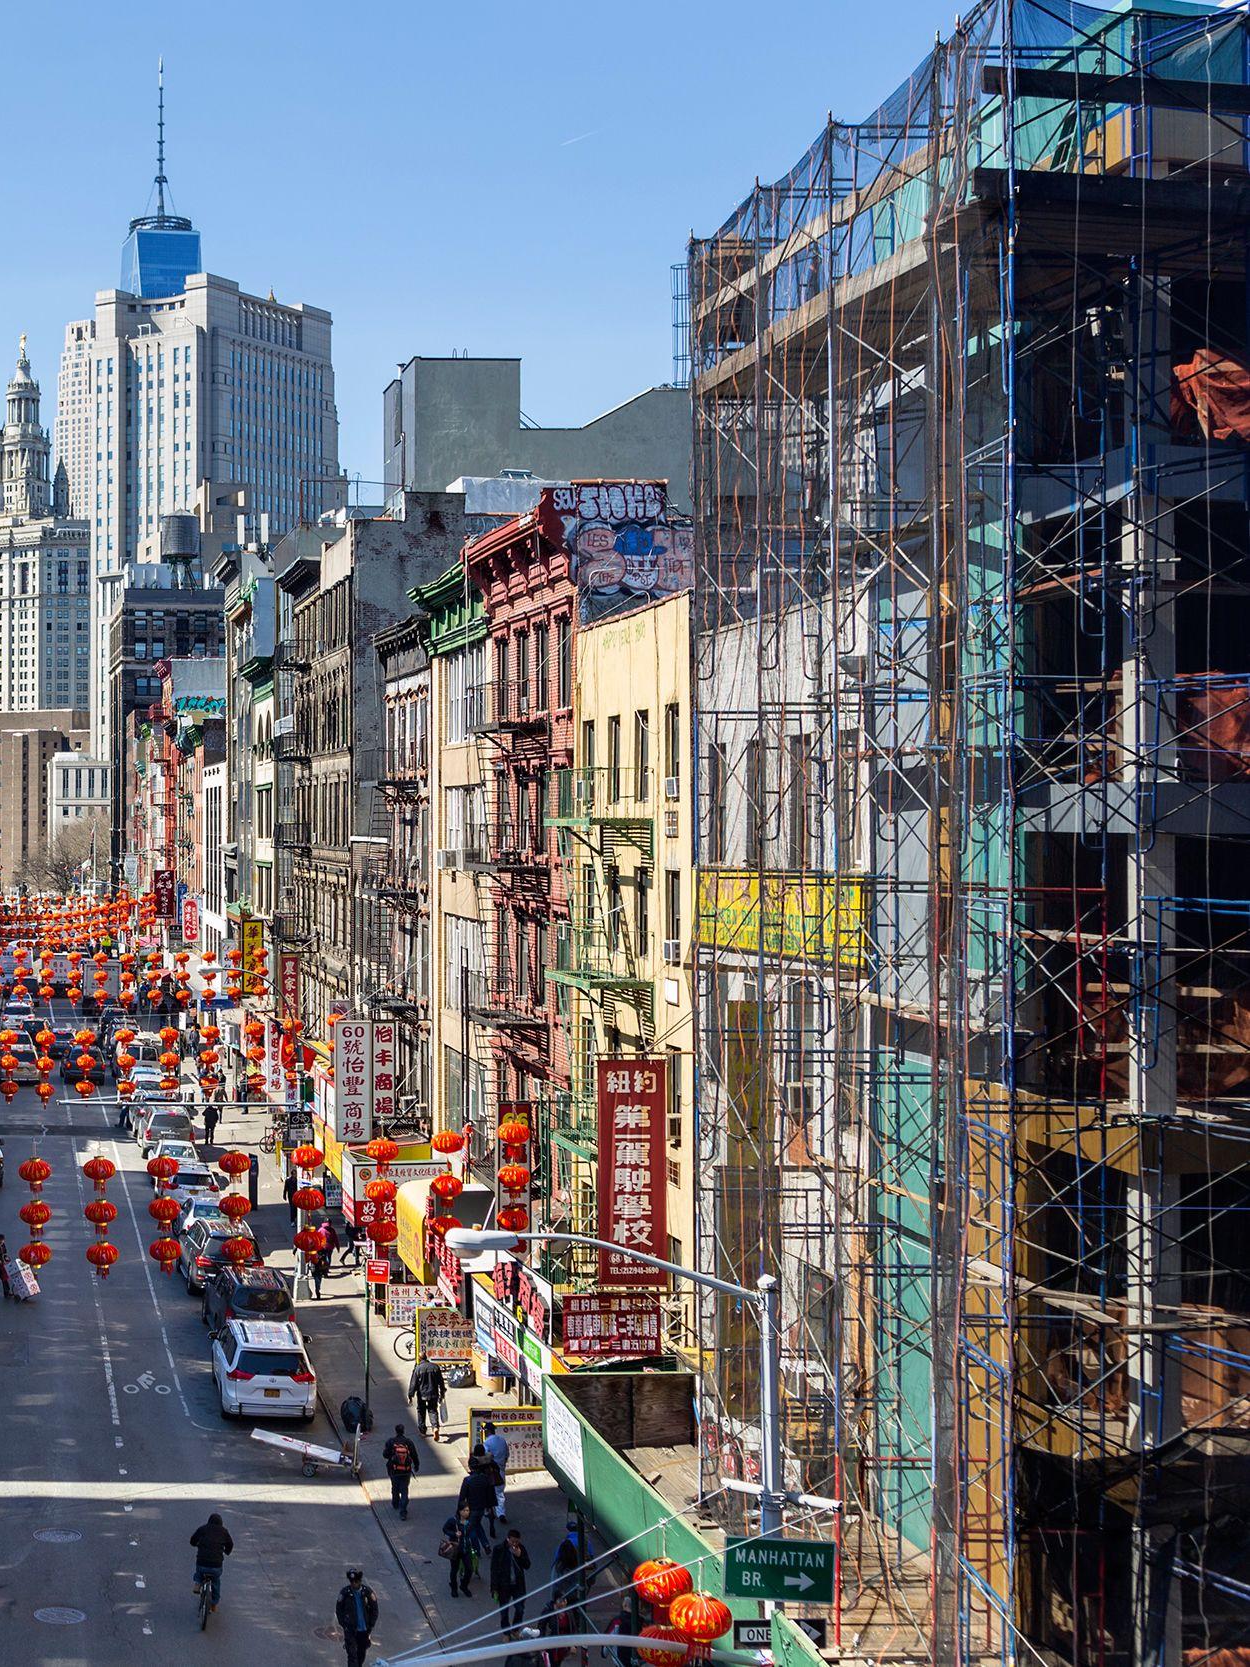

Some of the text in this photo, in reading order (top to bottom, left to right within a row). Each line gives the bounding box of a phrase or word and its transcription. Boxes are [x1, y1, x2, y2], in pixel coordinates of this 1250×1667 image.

[606, 1069, 657, 1094] 紐約
[612, 1104, 654, 1247] 第一駕駛學校
[735, 1548, 826, 1568] MANHATTAN
[741, 1571, 766, 1588] BR.
[747, 1628, 772, 1641] ONE
